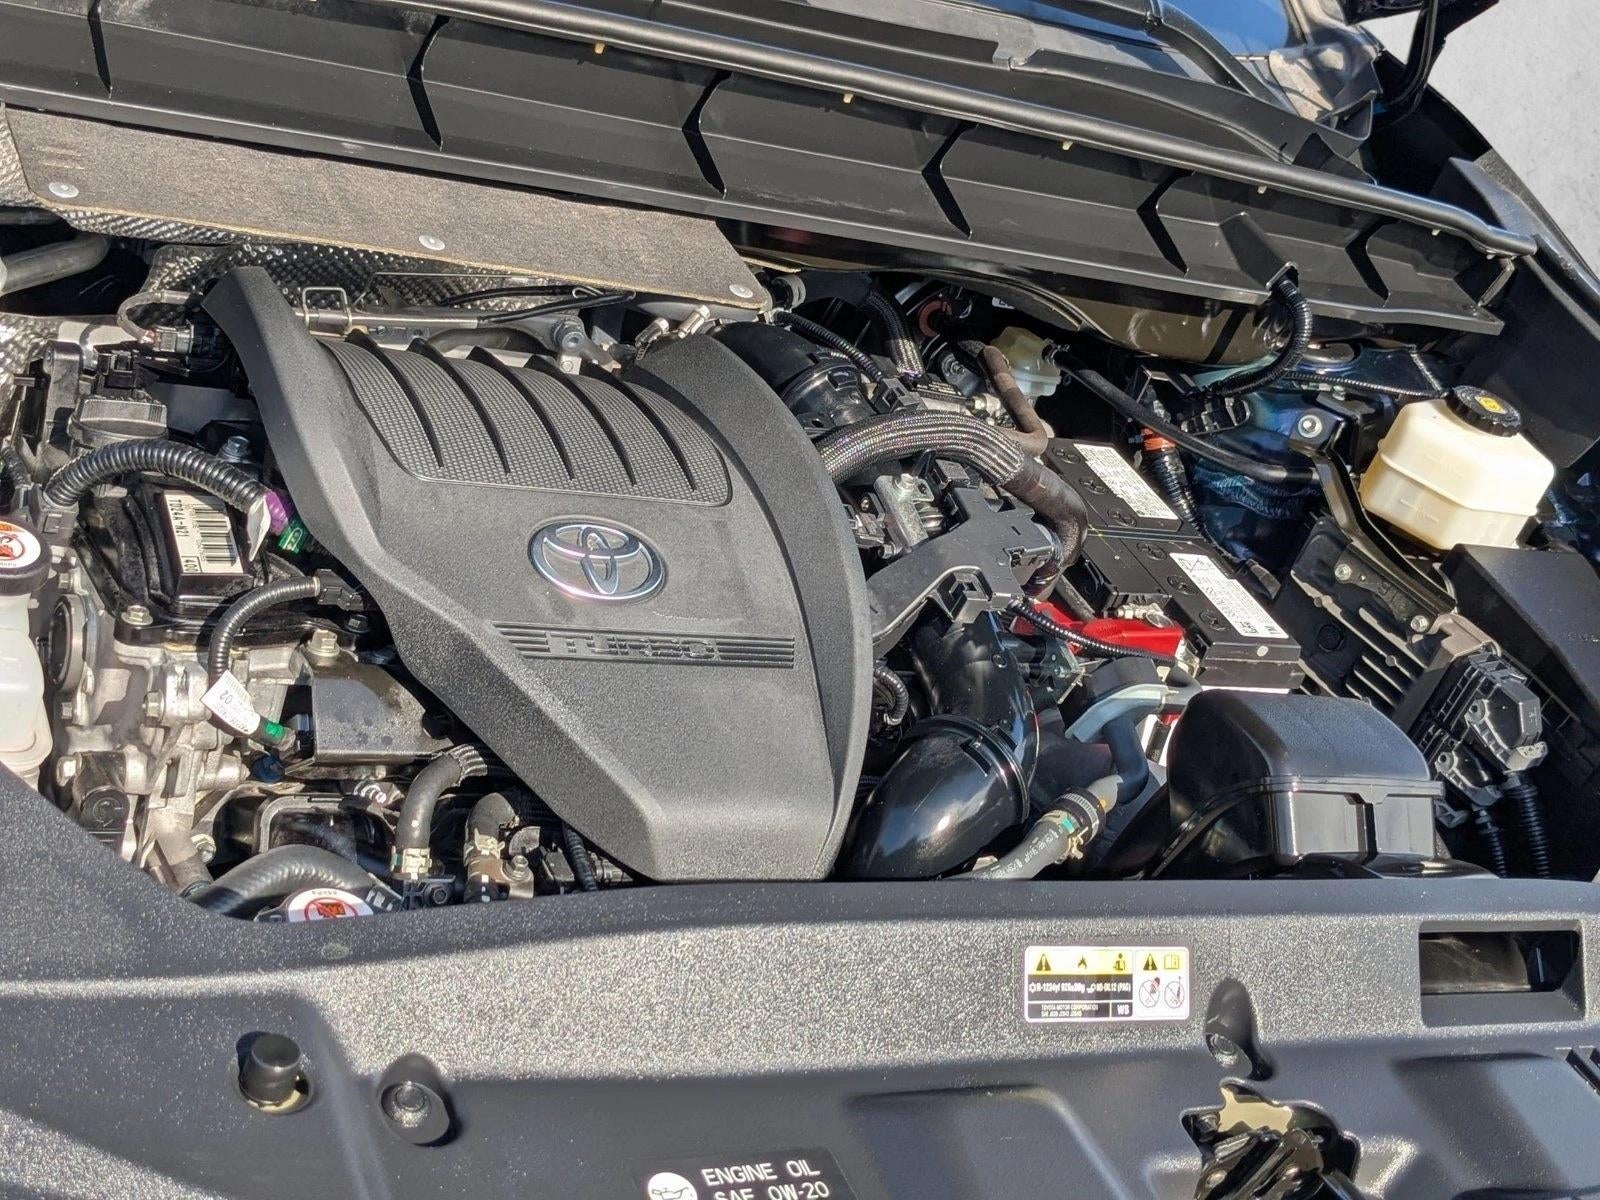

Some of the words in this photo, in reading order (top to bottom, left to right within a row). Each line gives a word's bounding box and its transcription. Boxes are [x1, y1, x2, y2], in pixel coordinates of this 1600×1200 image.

[549, 630, 718, 661] TURBO
[1117, 1004, 1130, 1015] WS
[701, 1162, 778, 1187] ENGINE
[786, 1159, 821, 1177] OIL
